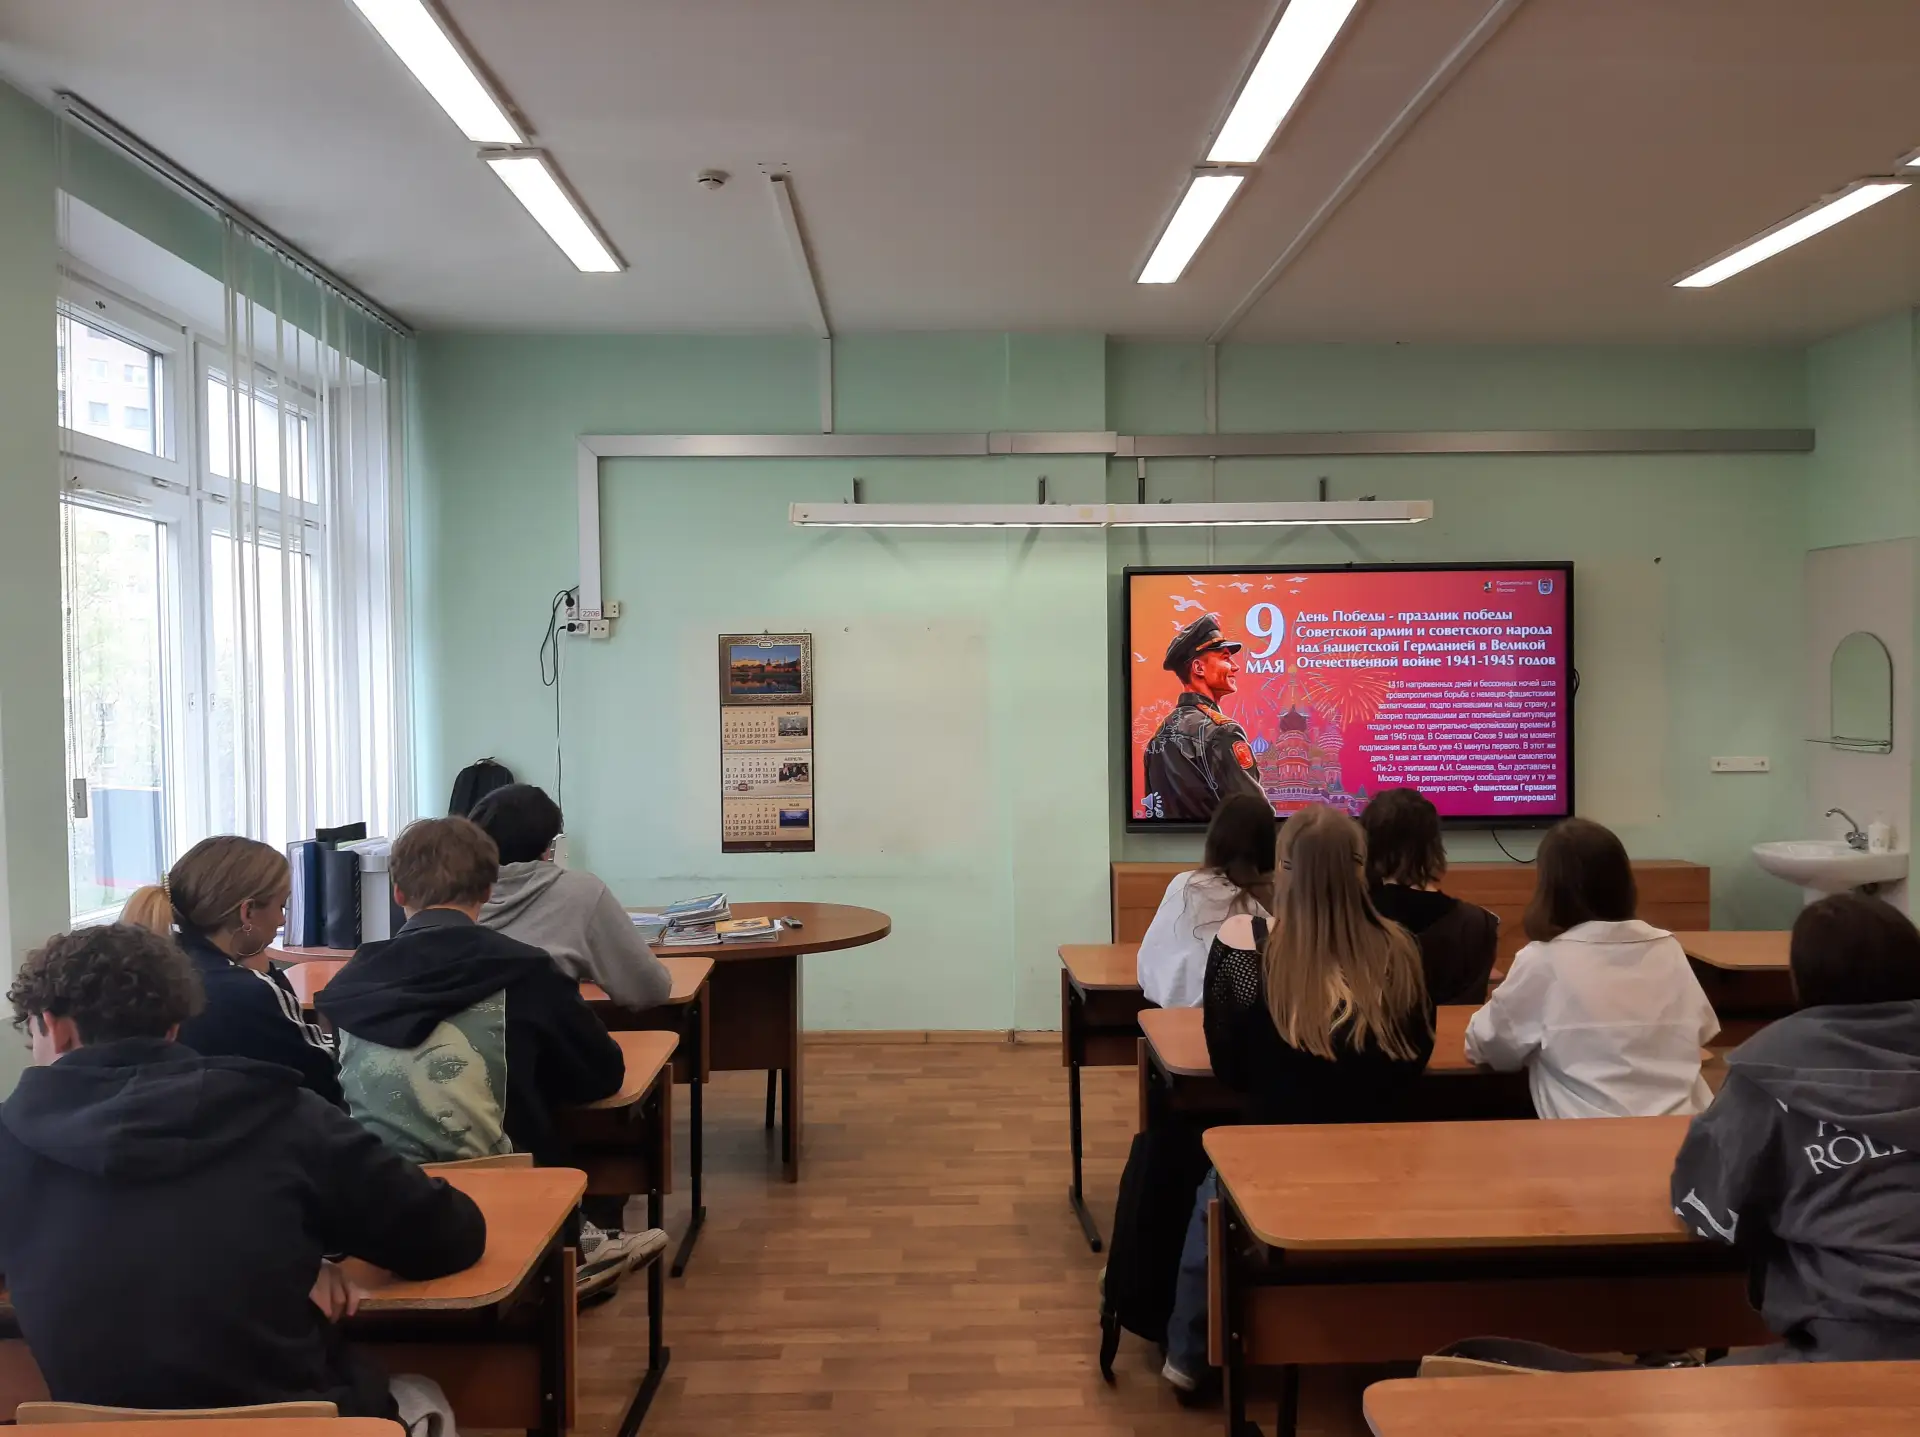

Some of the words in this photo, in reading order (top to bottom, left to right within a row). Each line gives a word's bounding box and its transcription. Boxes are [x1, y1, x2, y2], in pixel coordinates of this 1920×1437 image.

[1296, 611, 1329, 622] День
[1332, 610, 1385, 622] Победы
[1398, 612, 1459, 625] праздник
[1463, 609, 1513, 620] победы
[1245, 603, 1285, 659] 9
[1296, 626, 1367, 638] Советской
[1370, 627, 1413, 640] армии
[1416, 628, 1425, 636] и
[1429, 626, 1503, 636] советского
[1506, 626, 1552, 638] народа
[1296, 644, 1320, 653] над
[1323, 641, 1399, 653] нацистской
[1403, 640, 1476, 654] Германией
[1479, 642, 1487, 651] в
[1491, 638, 1546, 651] Великой
[1246, 659, 1285, 674] МАЯ
[1296, 656, 1398, 669] Отечественной
[1402, 656, 1442, 667] войне
[1446, 655, 1515, 666] 1941-1945
[1518, 656, 1556, 666] годов
[1454, 680, 1472, 689] дней
[1519, 679, 1540, 687] ночей
[1443, 690, 1469, 699] борьба
[1390, 732, 1407, 740] 1945
[1427, 732, 1433, 740] В
[1473, 732, 1497, 740] Союзе
[1370, 755, 1388, 763] день
[1406, 774, 1420, 782] Все
[1476, 773, 1513, 782] сообщали
[1473, 784, 1519, 793] фашистская
[1519, 783, 1556, 792] Германия
[1804, 1133, 1908, 1175] ROL
